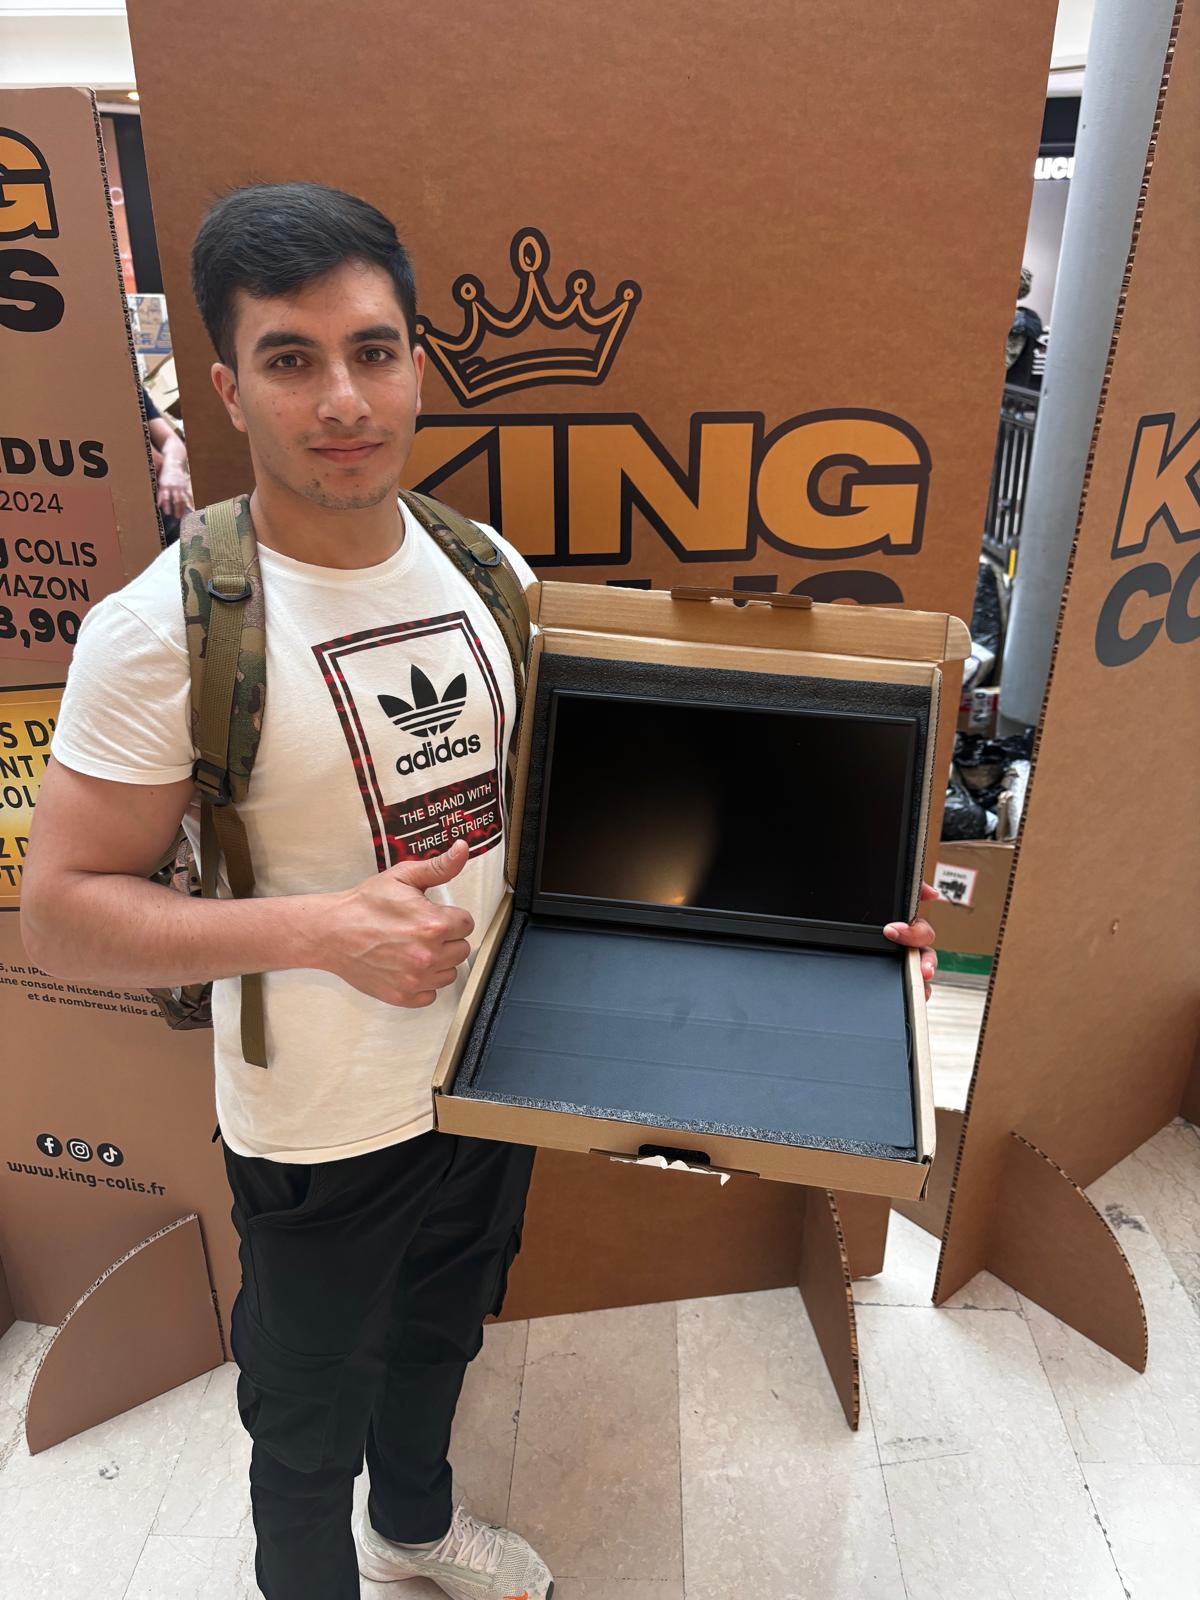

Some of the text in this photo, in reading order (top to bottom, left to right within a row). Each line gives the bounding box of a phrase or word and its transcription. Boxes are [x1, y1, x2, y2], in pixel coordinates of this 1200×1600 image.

[0, 437, 109, 478] DUS
[0, 490, 63, 513] 2024
[15, 538, 97, 567] COLIS
[396, 734, 481, 775] adidas
[0, 785, 40, 808] OL
[400, 783, 492, 825] THE BRAND WITH
[439, 810, 463, 827] THE
[409, 811, 494, 854] THREE STRIPES
[10, 965, 26, 974] un
[20, 981, 65, 991] console
[67, 984, 121, 999] Nintendo
[124, 992, 160, 1004] Switc
[28, 992, 40, 1001] et
[42, 994, 57, 1003] de
[59, 997, 118, 1012] nombreux
[120, 1004, 148, 1016] kilos
[7, 1161, 166, 1196] www.king-colis.fr
